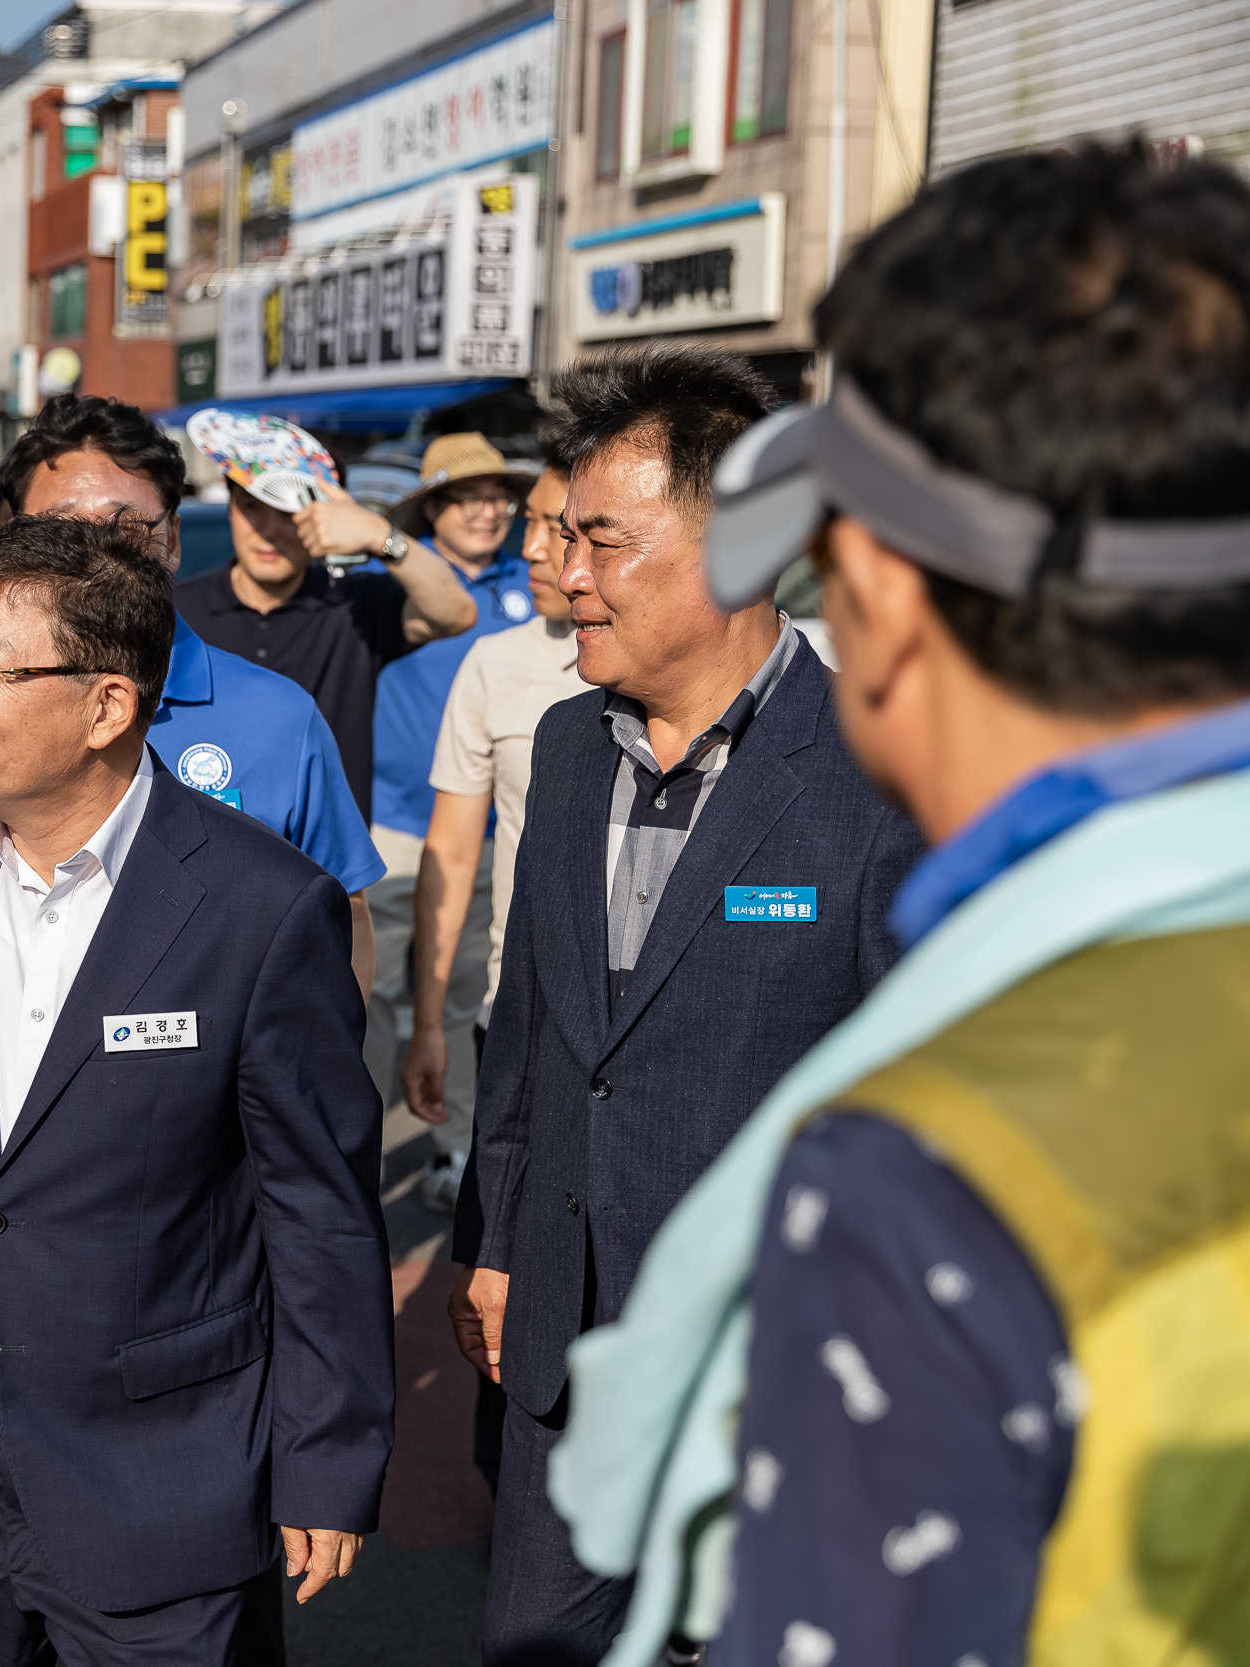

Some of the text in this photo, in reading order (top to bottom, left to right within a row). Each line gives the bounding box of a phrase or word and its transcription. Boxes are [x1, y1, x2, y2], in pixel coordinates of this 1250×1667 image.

[126, 181, 167, 291] PC
[731, 903, 811, 917] 비서실장 위동환
[143, 1034, 182, 1044] 광진구청장
